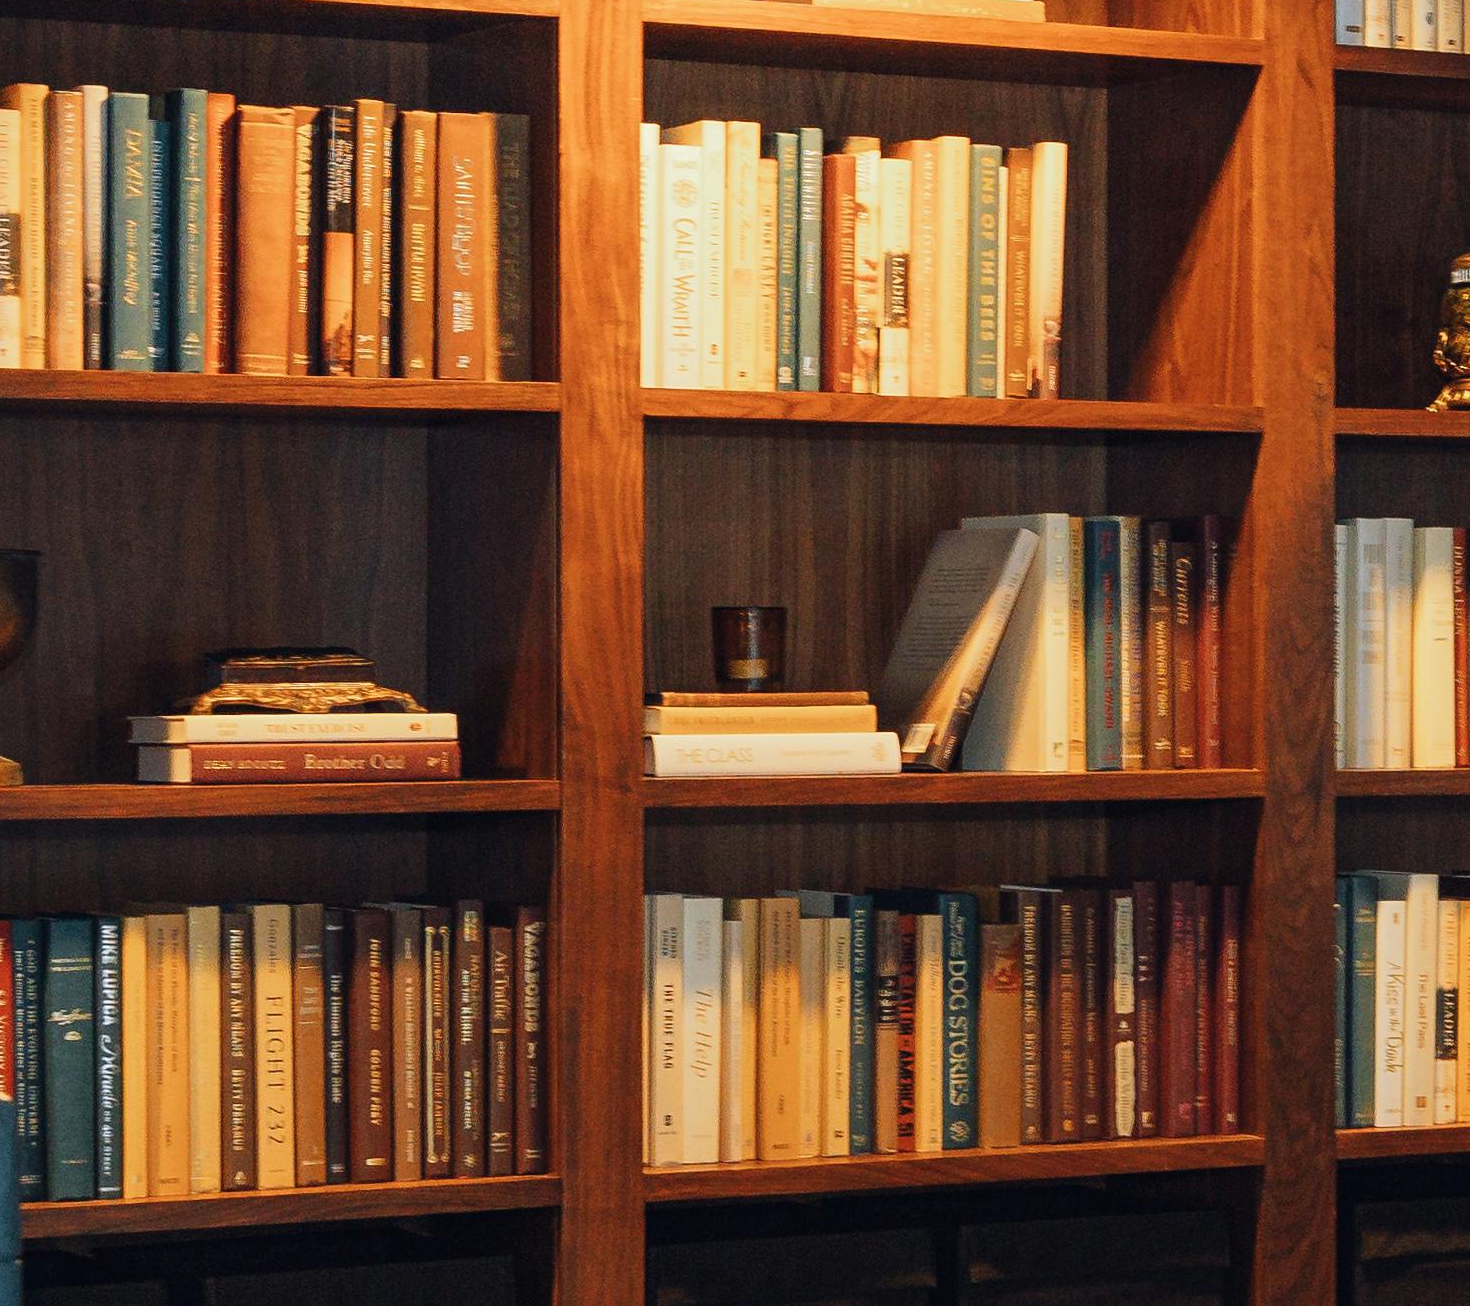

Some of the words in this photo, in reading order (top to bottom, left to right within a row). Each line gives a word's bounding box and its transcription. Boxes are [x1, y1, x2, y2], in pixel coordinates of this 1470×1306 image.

[304, 754, 365, 769] Brother
[370, 755, 405, 768] Odd
[676, 749, 705, 763] THE
[102, 925, 117, 964] MIKE
[102, 969, 118, 1025] LUPICA
[948, 960, 968, 1011] DOG
[695, 991, 713, 1024] The
[265, 996, 284, 1092] FLIGHT
[690, 1031, 711, 1078] Help
[948, 1016, 968, 1106] STORIES
[268, 1105, 284, 1144] 232
